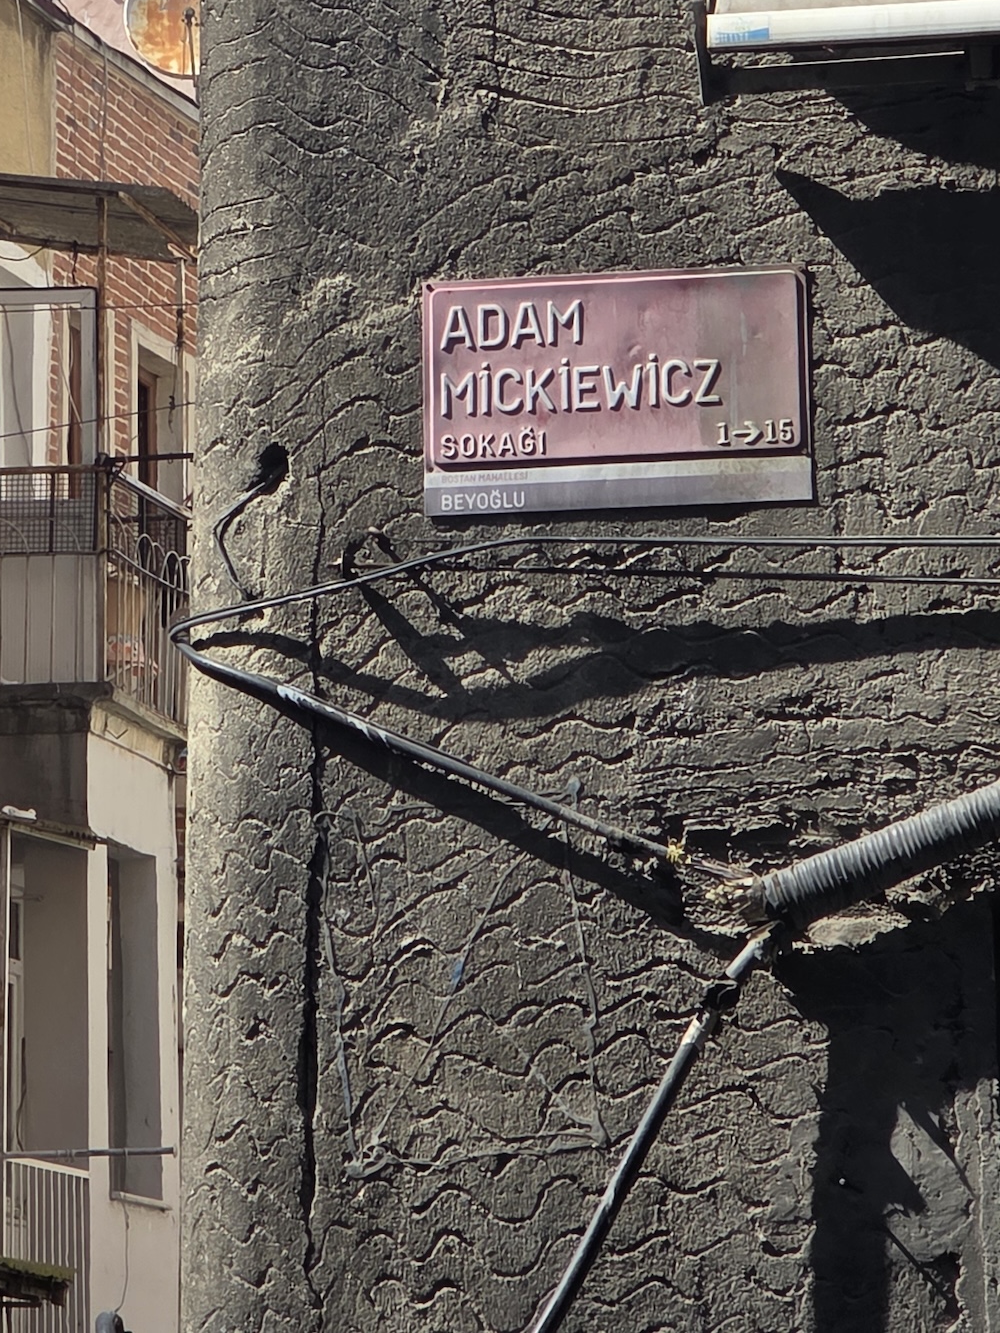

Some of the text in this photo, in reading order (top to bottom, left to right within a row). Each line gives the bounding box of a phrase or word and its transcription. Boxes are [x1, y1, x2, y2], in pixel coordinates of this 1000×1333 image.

[440, 299, 583, 352] ADAM
[440, 353, 724, 418] MİCKİEWİCZ
[440, 426, 547, 459] SOKAĞI
[442, 474, 476, 484] BOSTAN
[441, 489, 525, 511] BEYOĞLU
